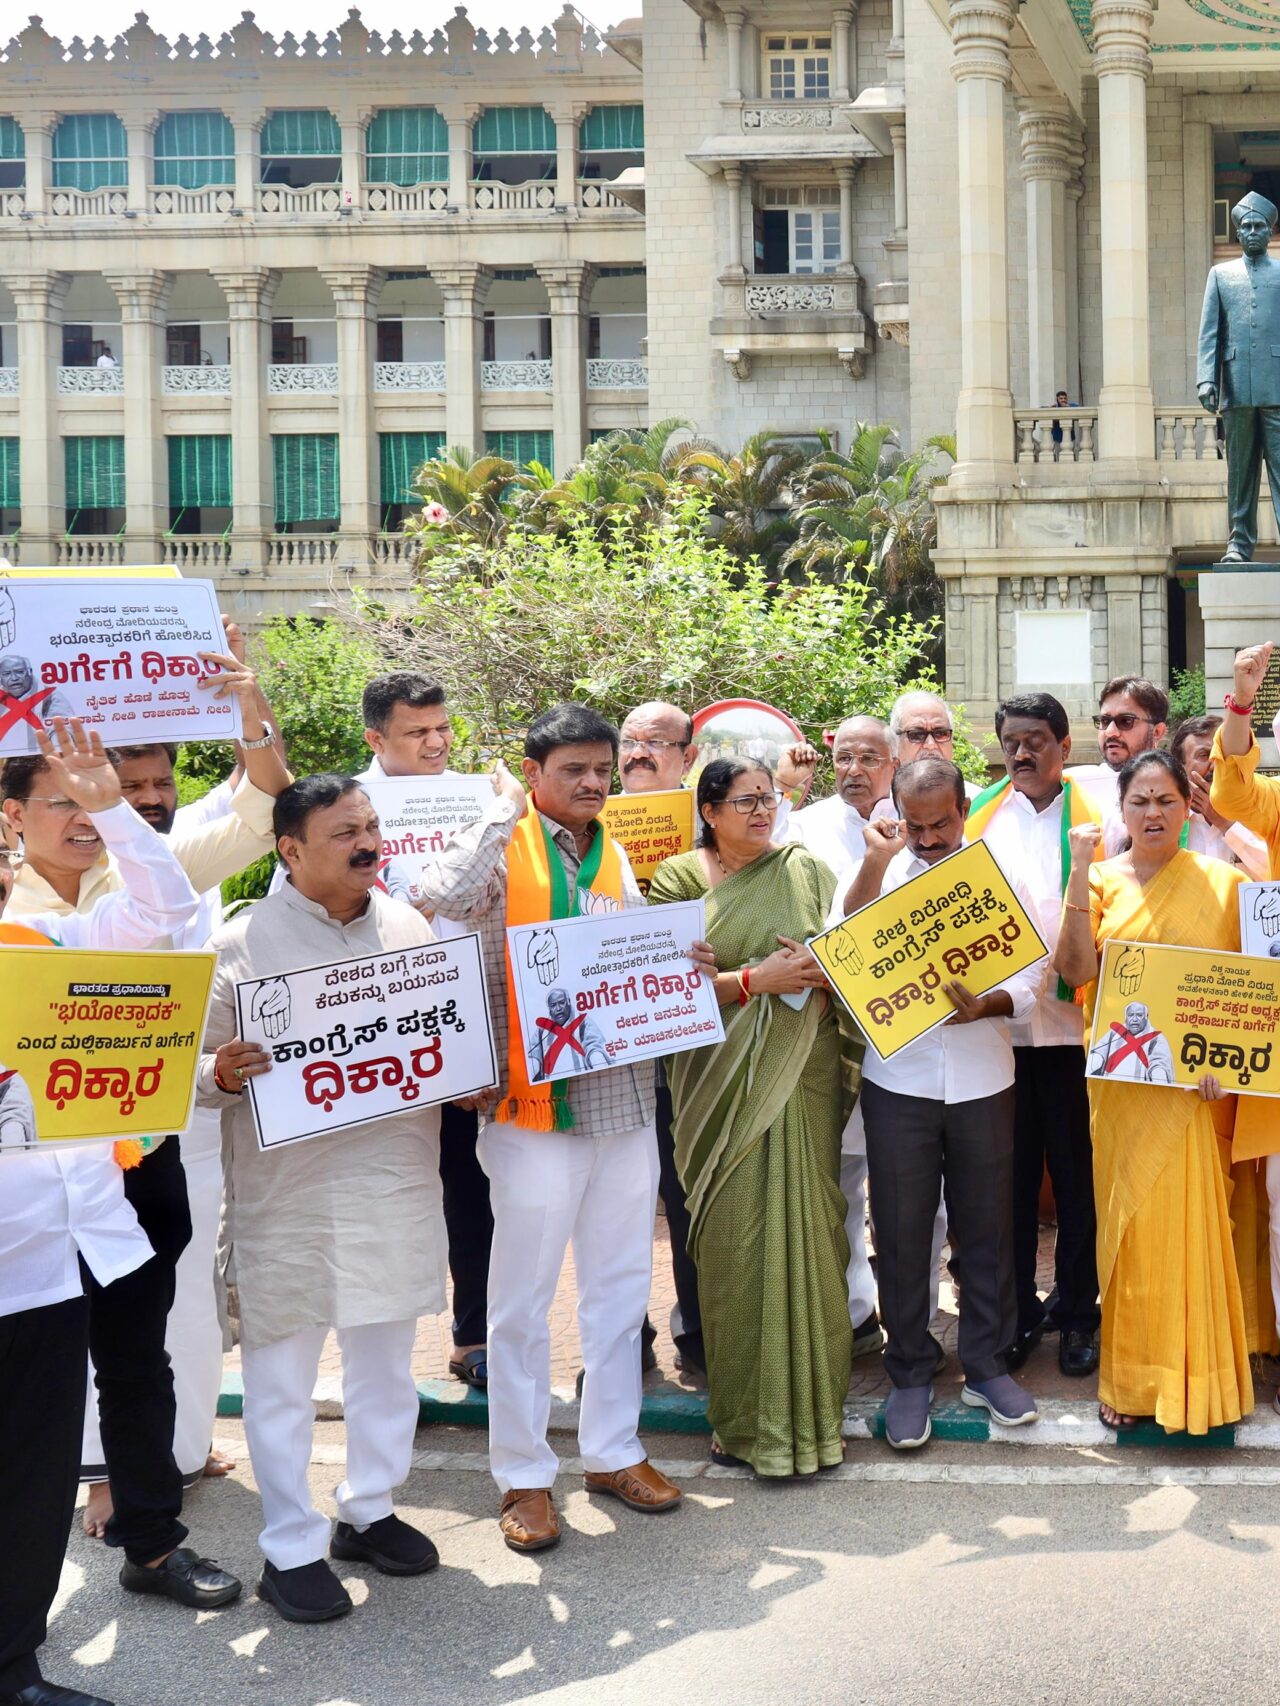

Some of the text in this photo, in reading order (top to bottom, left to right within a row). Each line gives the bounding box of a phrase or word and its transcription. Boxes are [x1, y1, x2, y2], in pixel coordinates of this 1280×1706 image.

[40, 650, 132, 684] ಖರ್ಗೆಗೆ
[868, 887, 1007, 978] ಕಾಂಗ್ರೆಸ್ ಪಕ್ಷಕ್ಕೆ
[872, 881, 972, 949] ದೇಶ ವಿರೋಧಿ
[324, 950, 446, 986] ದೇಶದ ಬಗ್ಗೆ ಸದಾ
[387, 965, 459, 994] ಬಯಸುವ
[575, 969, 701, 1011] ಖರ್ಗೆಗೆ ಧಿಕ್ಕಾರ
[866, 915, 1021, 1027] ಧಿಕ್ಕಾರ ಧಿಕ್ಕಾರ
[16, 1034, 57, 1049] ಎಂದ
[155, 1031, 195, 1047] ಖರ್ಗೆಗೆ
[271, 999, 465, 1064] ಕಾಂಗ್ರೆಸ್ ಪಕ್ಷಕ್ಕೆ
[1180, 1032, 1272, 1085] ಧಿಕ್ಕಾರ
[45, 1057, 164, 1116] ಧಿಕ್ಕಾರ
[301, 1036, 443, 1112] ಧಿಕ್ಕಾರ
